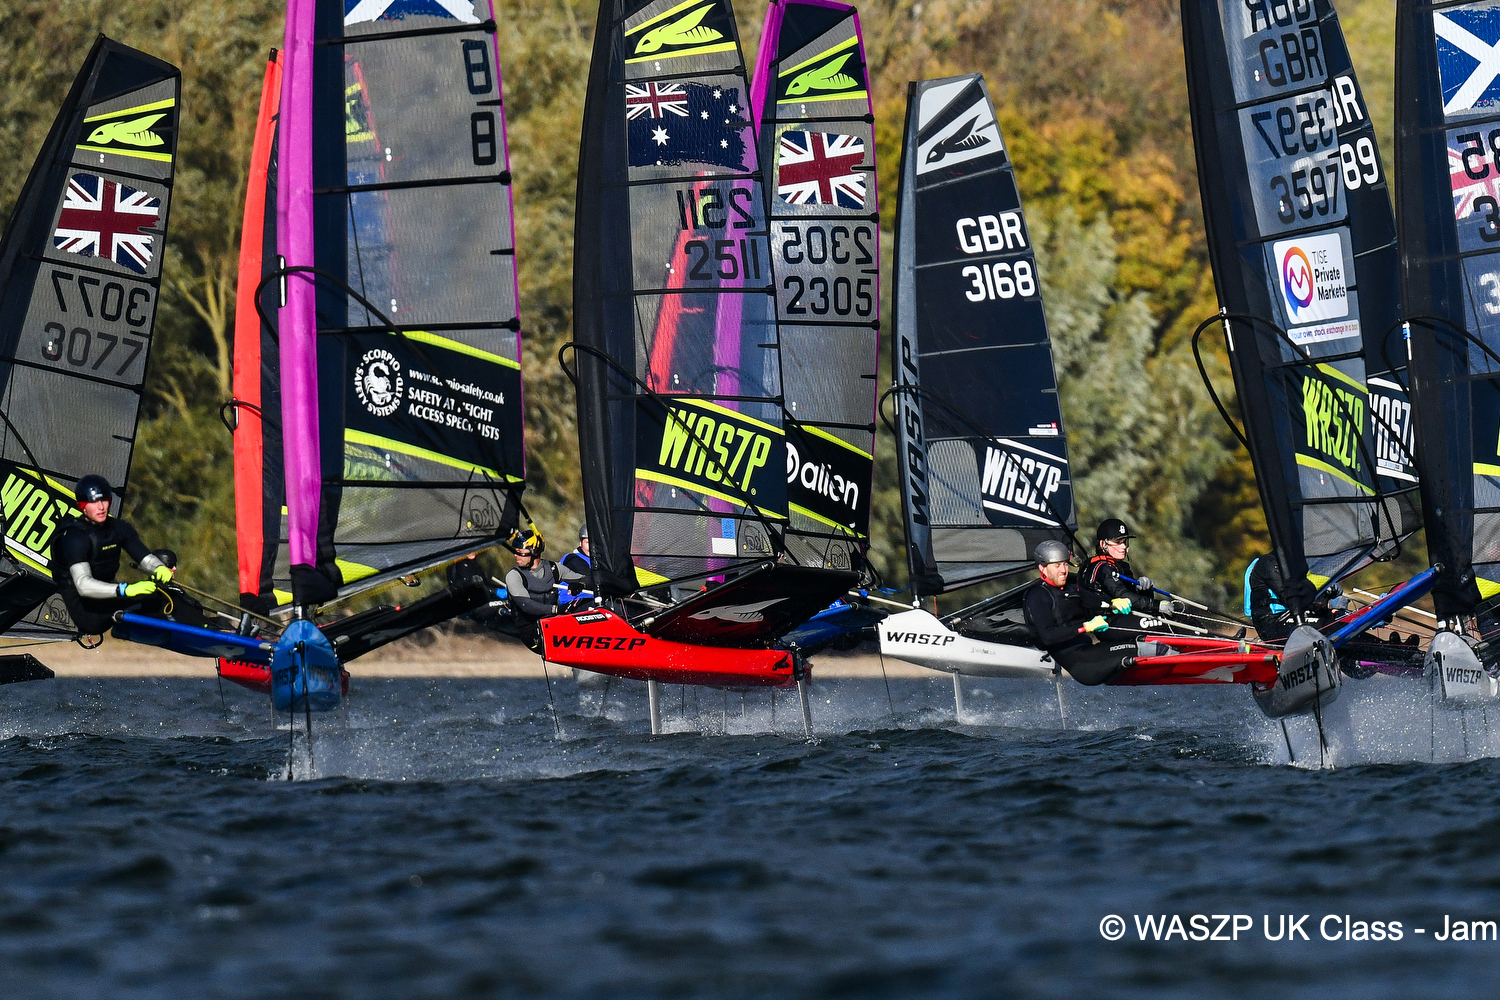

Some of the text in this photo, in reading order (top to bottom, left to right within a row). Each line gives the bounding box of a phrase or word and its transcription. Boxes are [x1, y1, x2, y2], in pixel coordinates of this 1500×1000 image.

[1258, 28, 1324, 87] GBR
[1270, 162, 1340, 225] 3597
[956, 212, 1026, 254] GBR
[684, 239, 760, 280] 2511
[1311, 249, 1328, 265] TISE
[962, 260, 1036, 303] 3168
[1314, 267, 1341, 283] Private
[784, 275, 872, 316] 2305
[1317, 284, 1346, 301] Markets
[41, 321, 144, 376] 3077
[362, 348, 401, 372] SCORPIO
[366, 398, 401, 417] SYSTEMS
[408, 387, 442, 407] SAFETY
[408, 403, 444, 424] ACCESS
[1302, 375, 1364, 469] WASZP
[901, 334, 930, 527] WASZP
[658, 406, 771, 492] WASZP
[800, 461, 859, 510] alien
[981, 446, 1062, 514] WASZP
[575, 612, 605, 623] ROOSTER
[552, 635, 647, 651] WASZP
[887, 631, 956, 647] WASZP
[1109, 642, 1136, 652] ROOSTER
[1280, 660, 1320, 691] WASZP
[1446, 667, 1482, 684] WASZP
